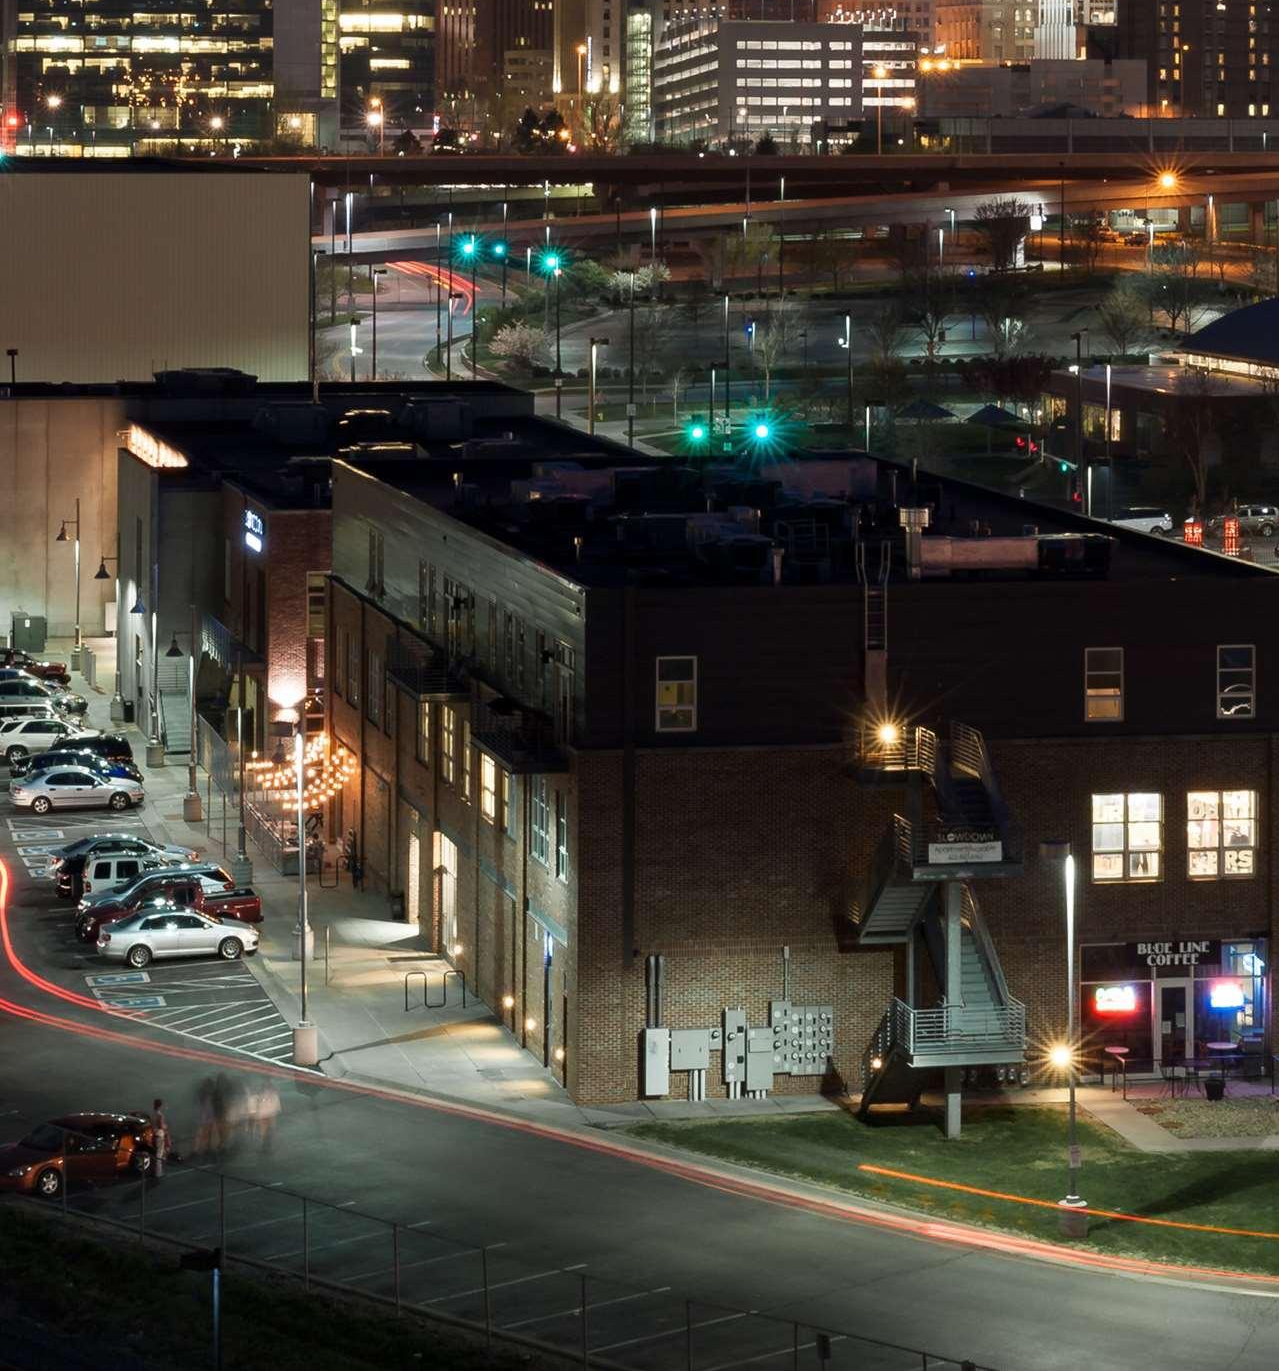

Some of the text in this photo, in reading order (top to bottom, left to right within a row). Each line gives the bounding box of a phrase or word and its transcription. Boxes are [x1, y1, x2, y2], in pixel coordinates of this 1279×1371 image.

[1137, 941, 1210, 954] BLUE LINE
[1147, 954, 1199, 966] COFFEE
